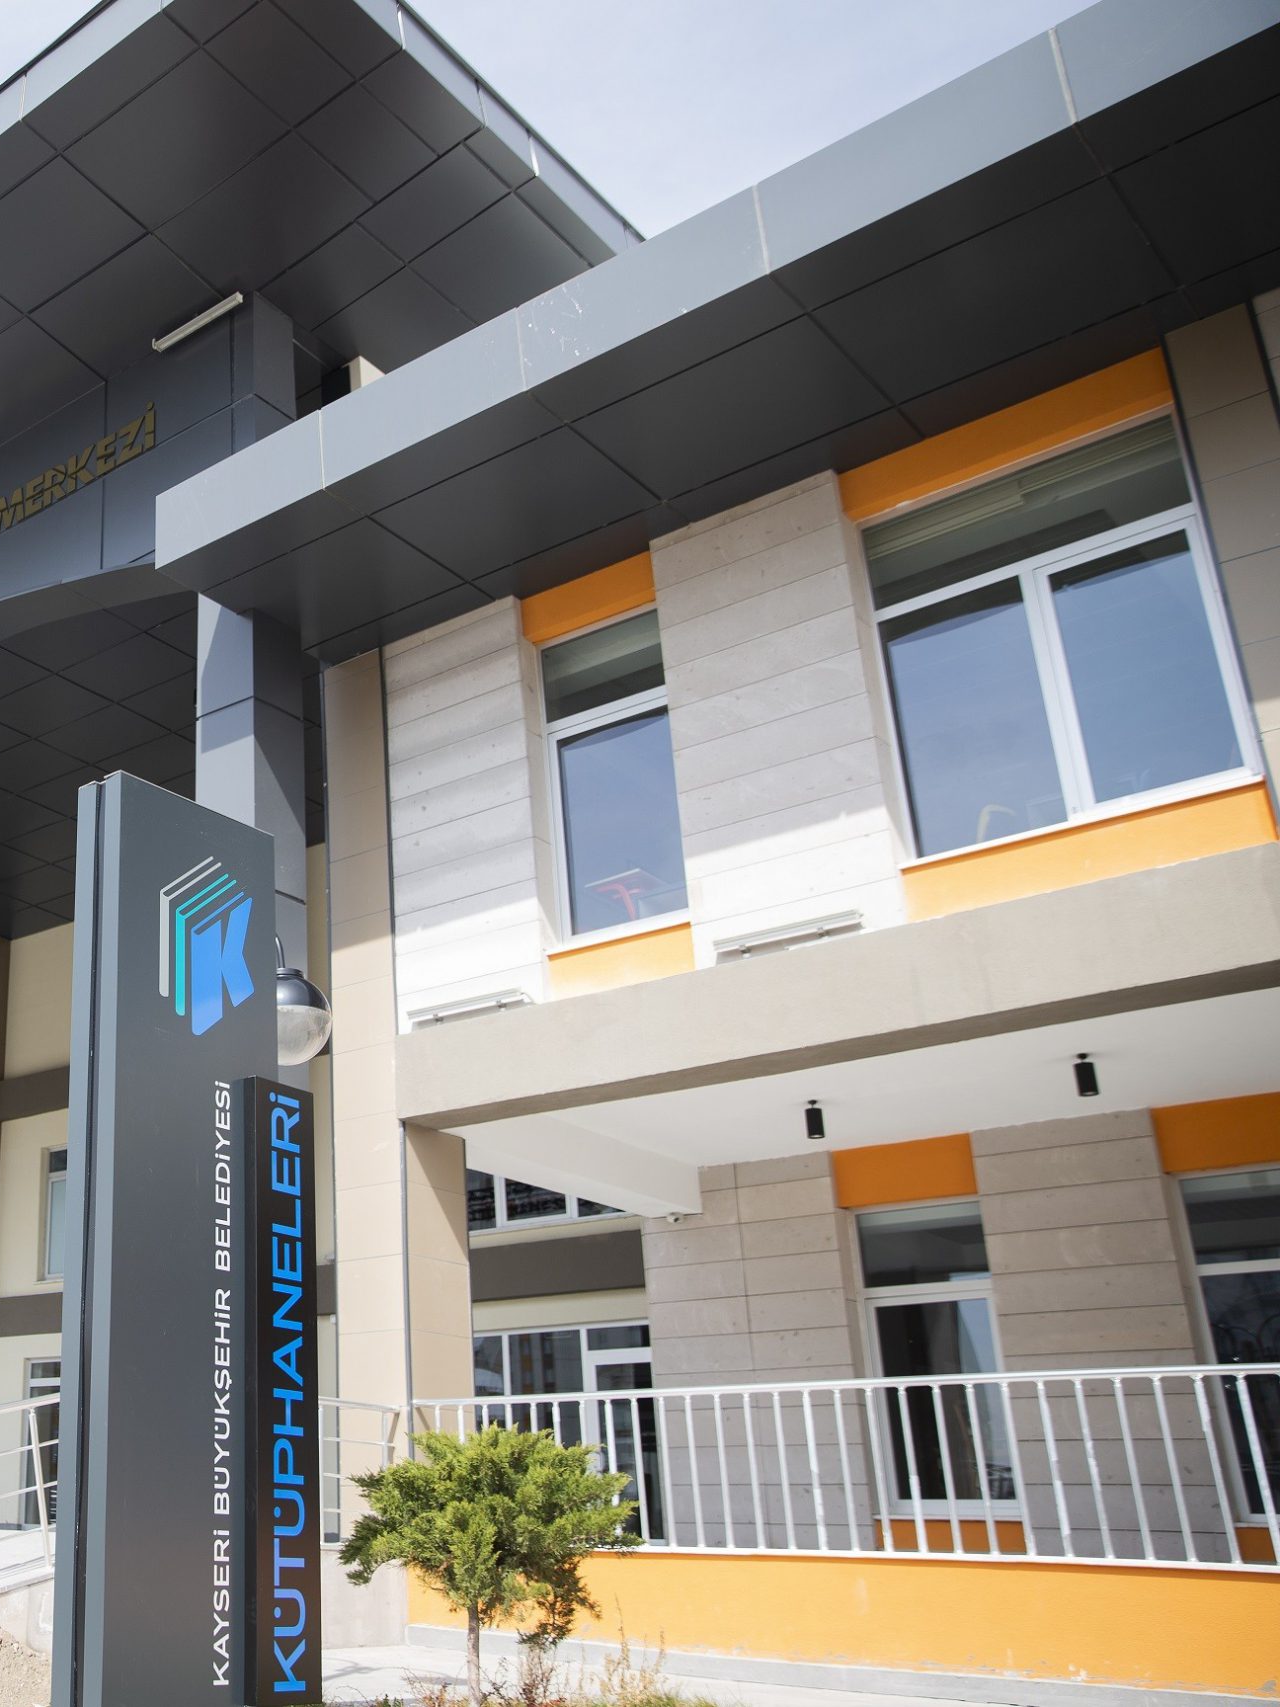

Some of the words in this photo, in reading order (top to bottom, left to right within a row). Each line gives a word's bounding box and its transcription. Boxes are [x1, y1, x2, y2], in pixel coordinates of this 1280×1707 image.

[214, 1080, 231, 1273] BELEDİYESİ
[214, 1287, 232, 1516] BÜYÜKŞEHİR
[269, 1092, 306, 1692] KÜTÜPHANELERİ
[212, 1529, 230, 1686] KAYSERİ
